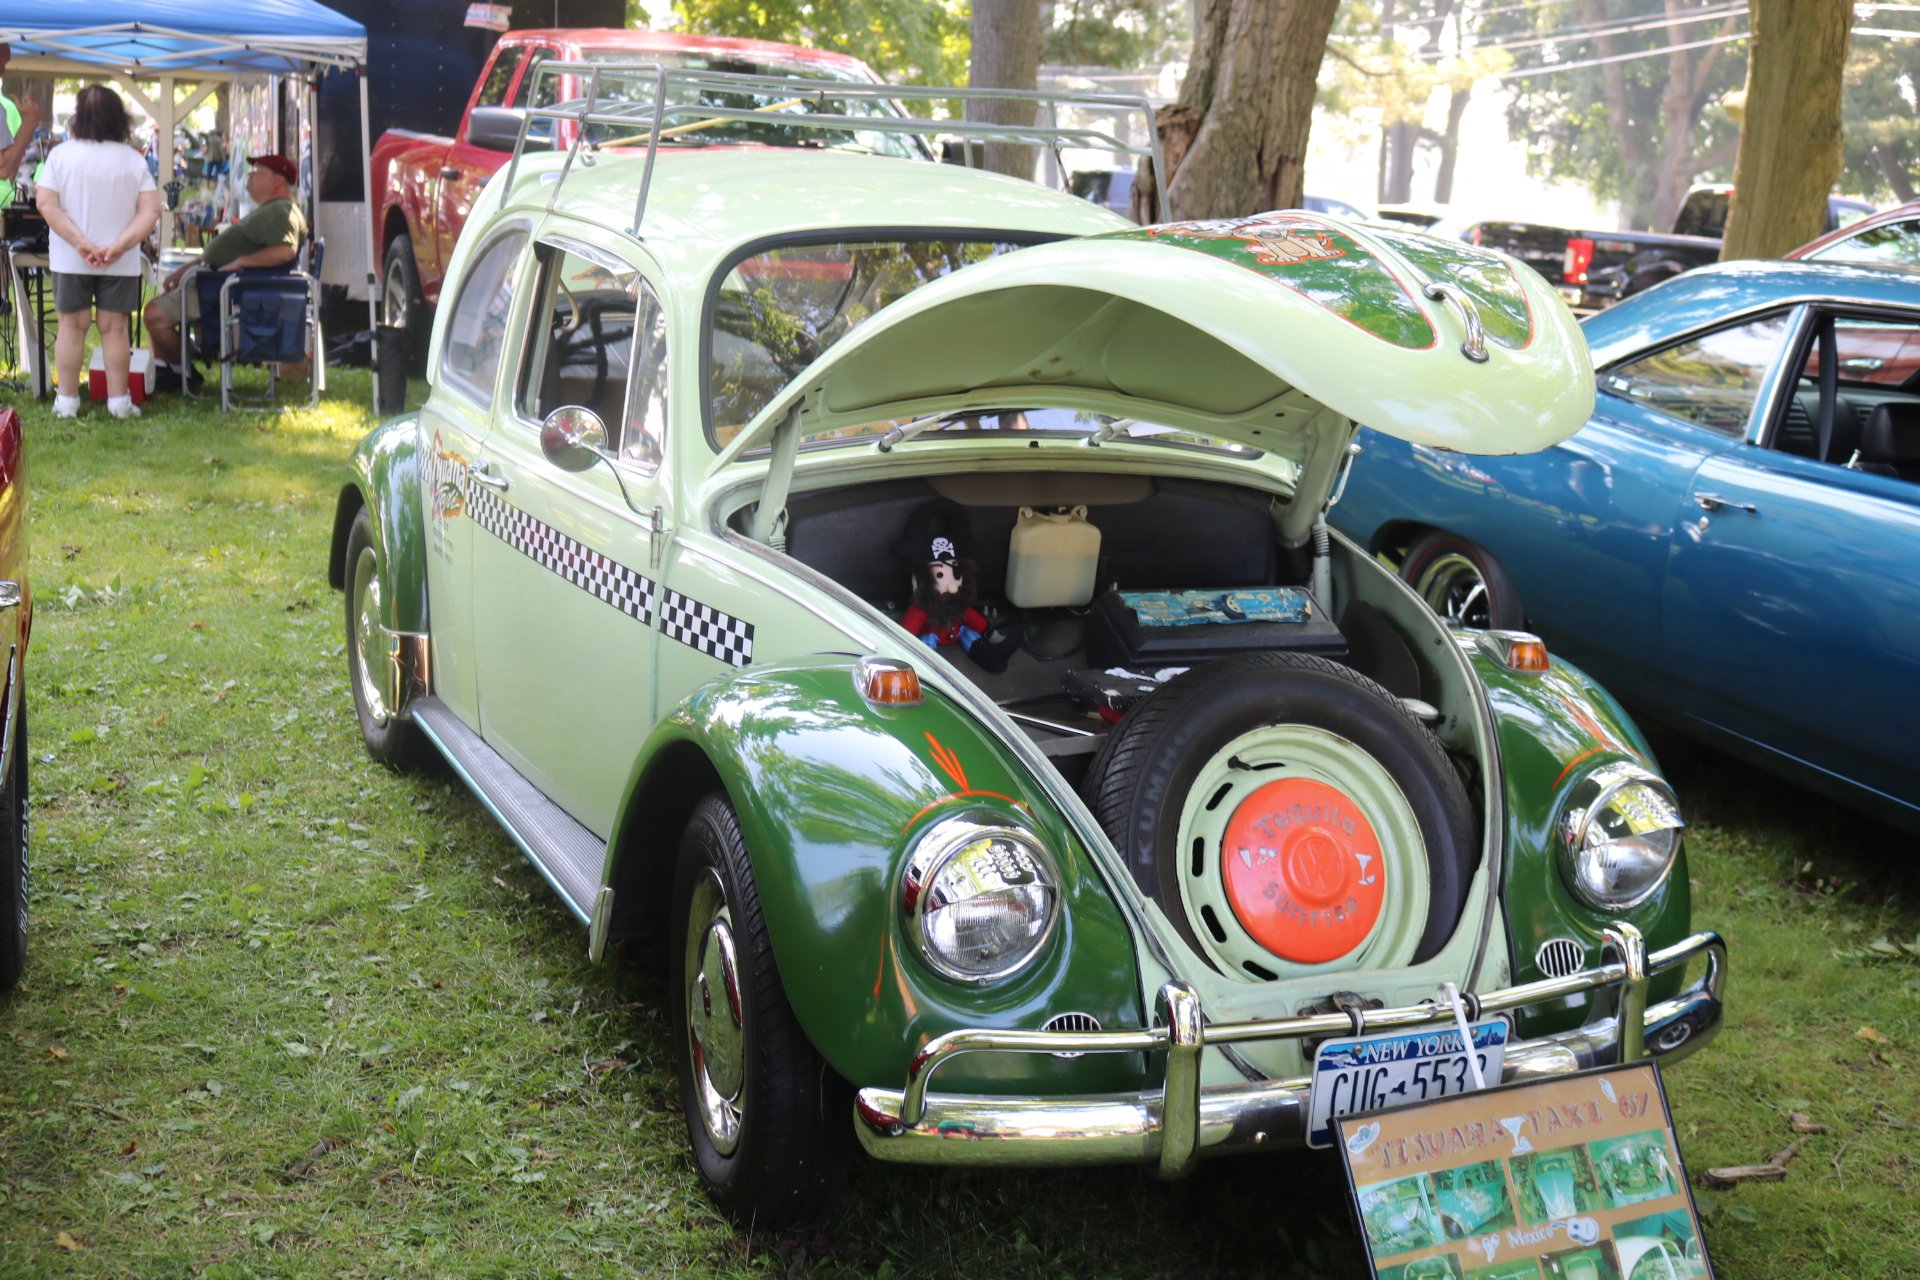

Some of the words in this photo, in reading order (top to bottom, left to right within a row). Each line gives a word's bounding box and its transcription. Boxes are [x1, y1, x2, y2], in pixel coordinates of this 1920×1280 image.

[1252, 803, 1357, 838] Tequila
[1262, 880, 1358, 928] Sunrise
[1365, 1038, 1413, 1064] NEW
[1416, 1032, 1467, 1057] YORK
[1526, 1098, 1604, 1136] TAXI
[1506, 1223, 1555, 1249] Mexico
